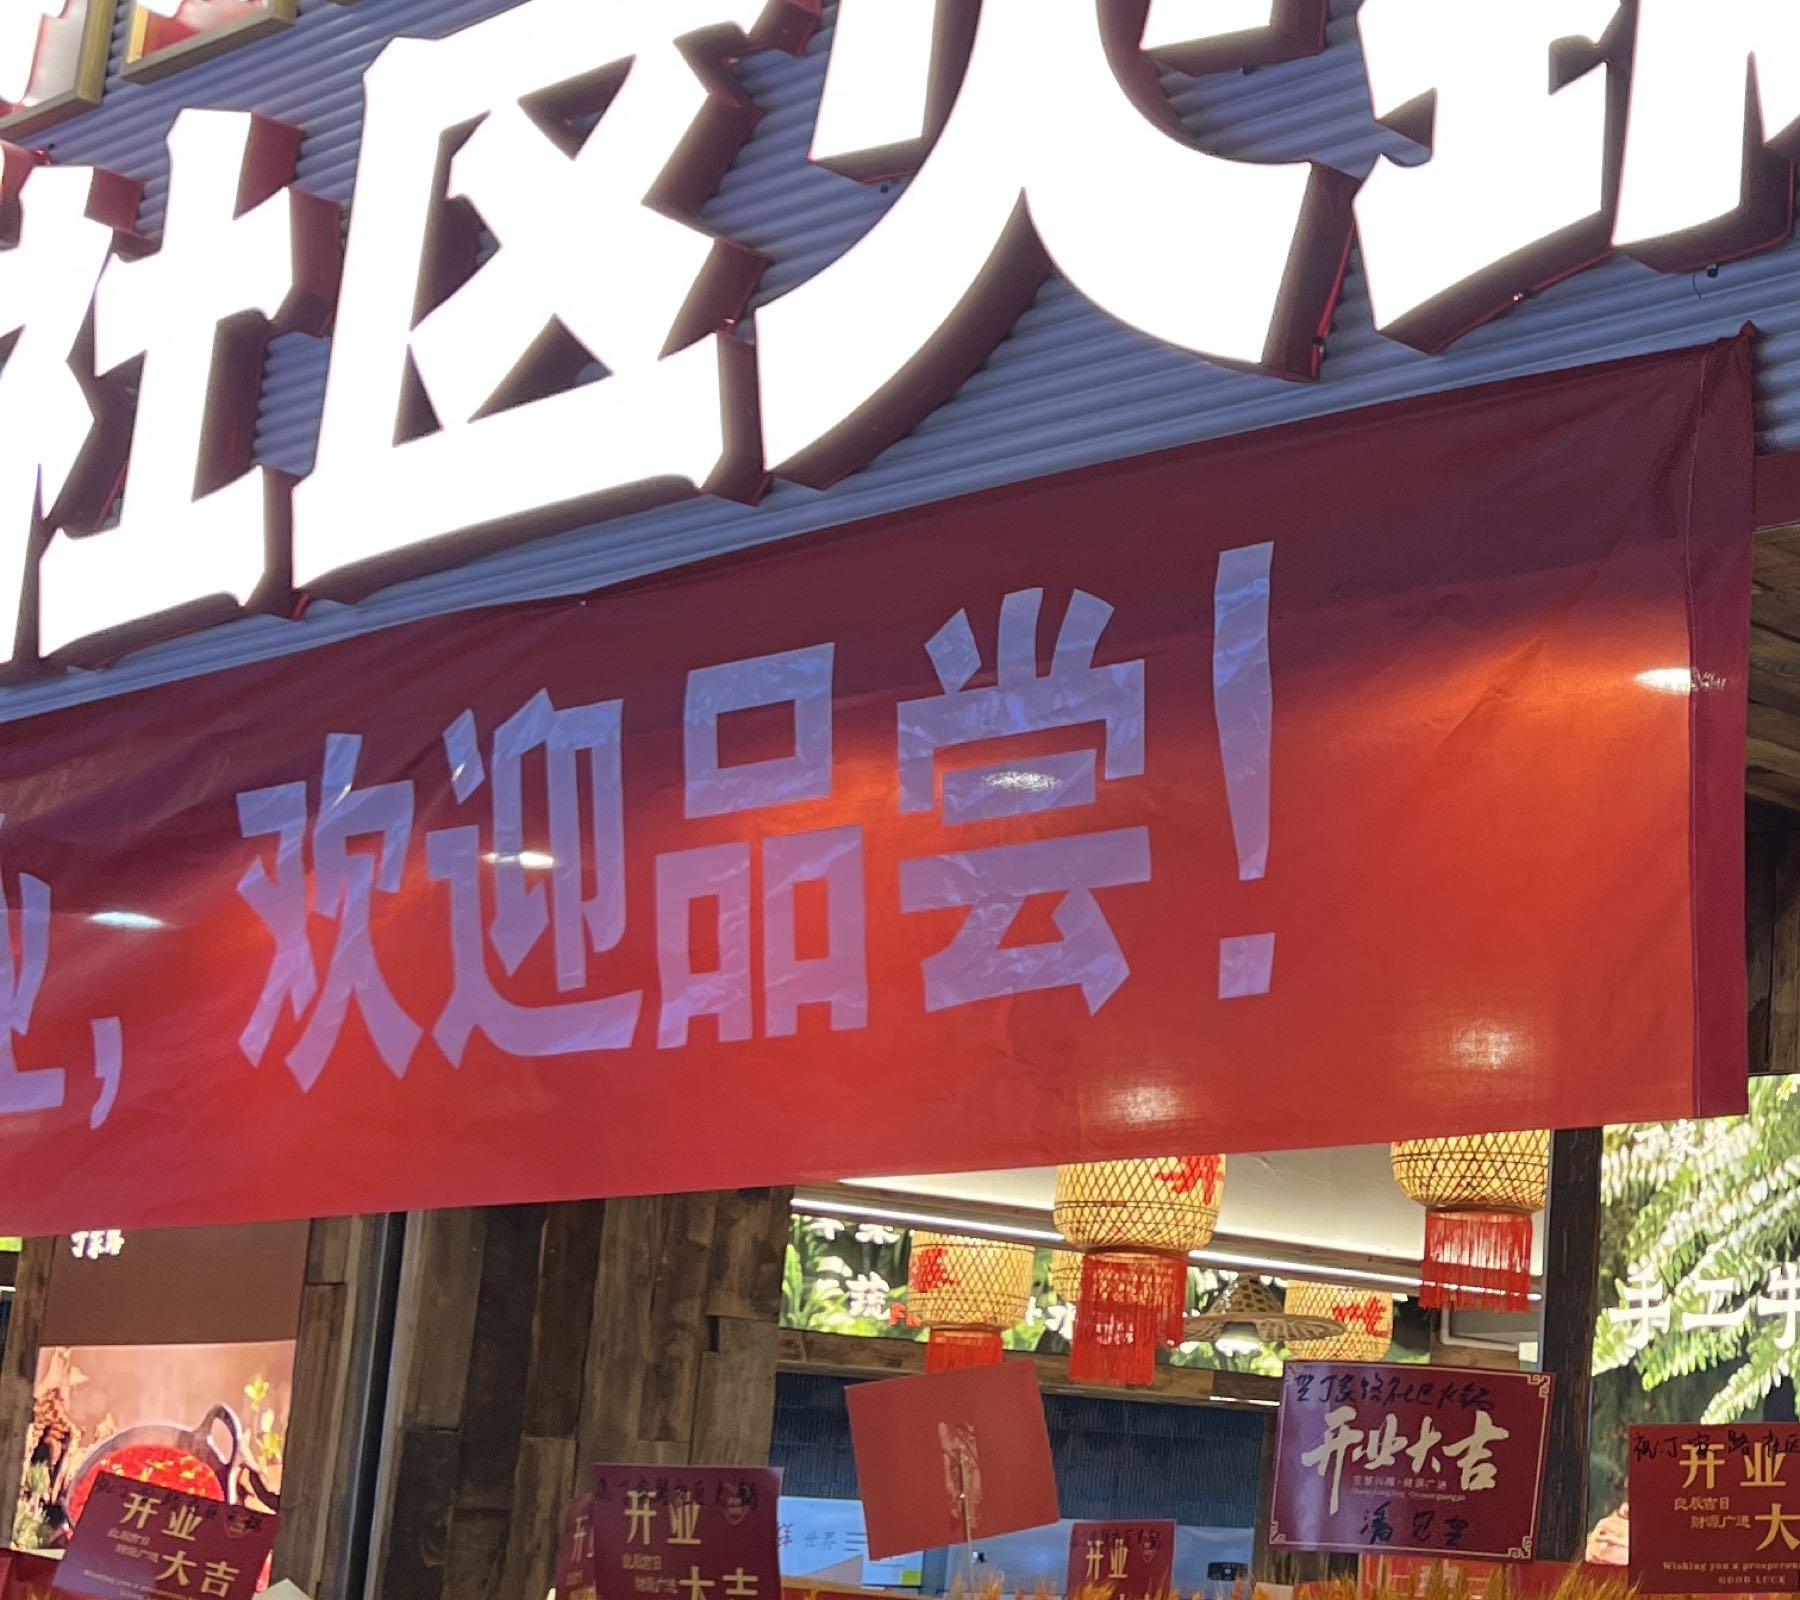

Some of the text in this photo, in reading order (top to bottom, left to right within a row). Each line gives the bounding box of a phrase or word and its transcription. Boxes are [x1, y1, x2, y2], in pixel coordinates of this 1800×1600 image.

[1301, 1405, 1510, 1516] 开业大吉
[1679, 1441, 1787, 1489] 开业
[118, 1491, 204, 1542] 开业
[624, 1488, 702, 1545] 开业
[155, 1550, 240, 1598] 大吉
[1085, 1538, 1129, 1580] 开业
